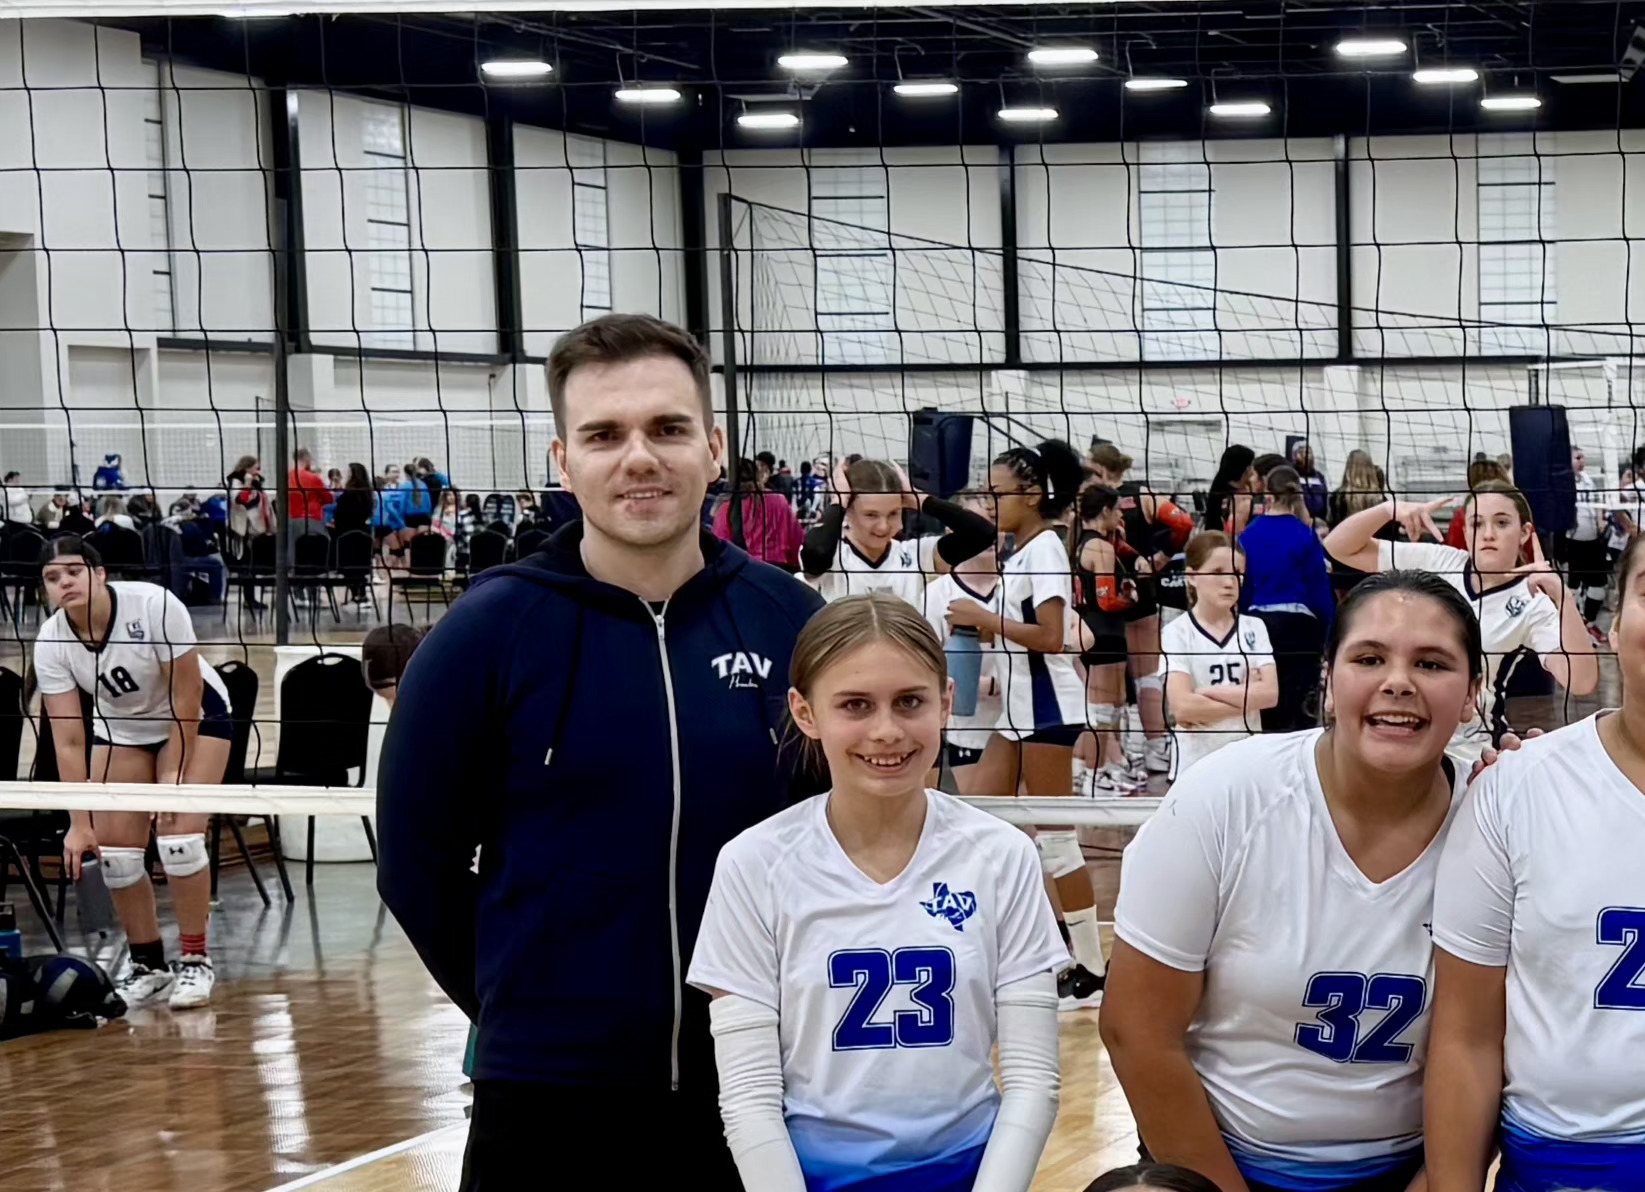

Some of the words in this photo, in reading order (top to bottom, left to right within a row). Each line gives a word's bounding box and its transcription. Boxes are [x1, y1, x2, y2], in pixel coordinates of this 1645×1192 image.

[710, 651, 773, 680] TAV
[1209, 662, 1241, 686] 25
[98, 665, 140, 698] 18
[928, 893, 973, 914] TAV
[827, 945, 957, 1053] 23
[1293, 971, 1428, 1065] 32
